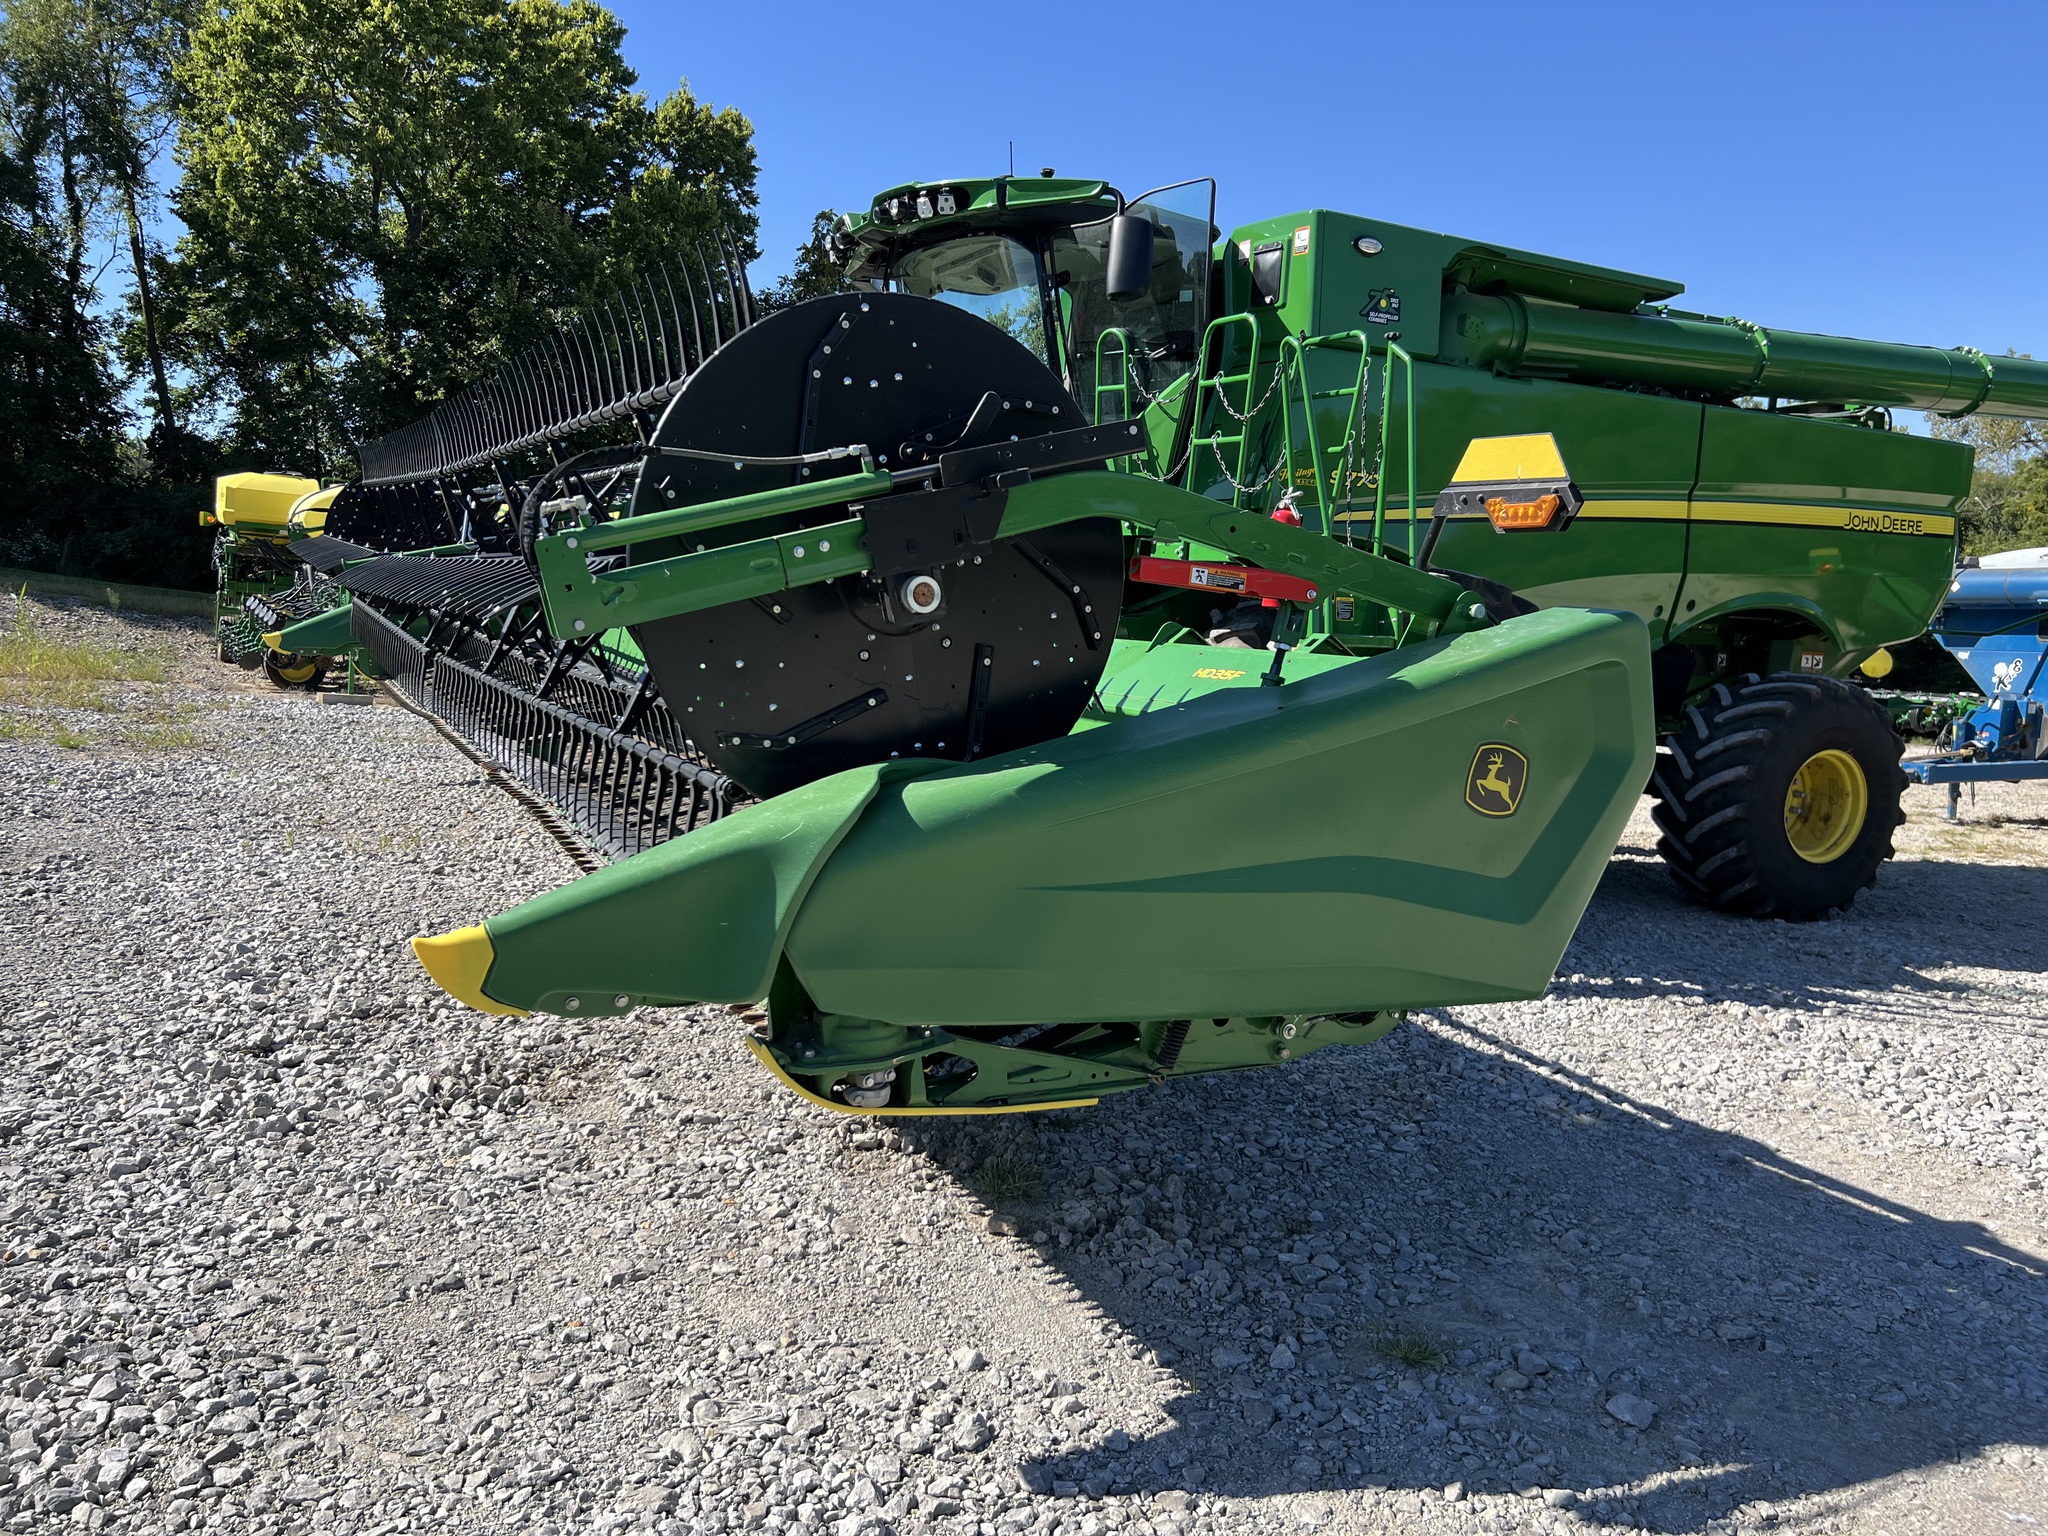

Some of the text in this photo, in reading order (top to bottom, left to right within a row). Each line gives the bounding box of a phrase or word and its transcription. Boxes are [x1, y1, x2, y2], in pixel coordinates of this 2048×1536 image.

[1843, 511, 1923, 533] JOHN DEERE
[1191, 667, 1247, 681] HD35F
